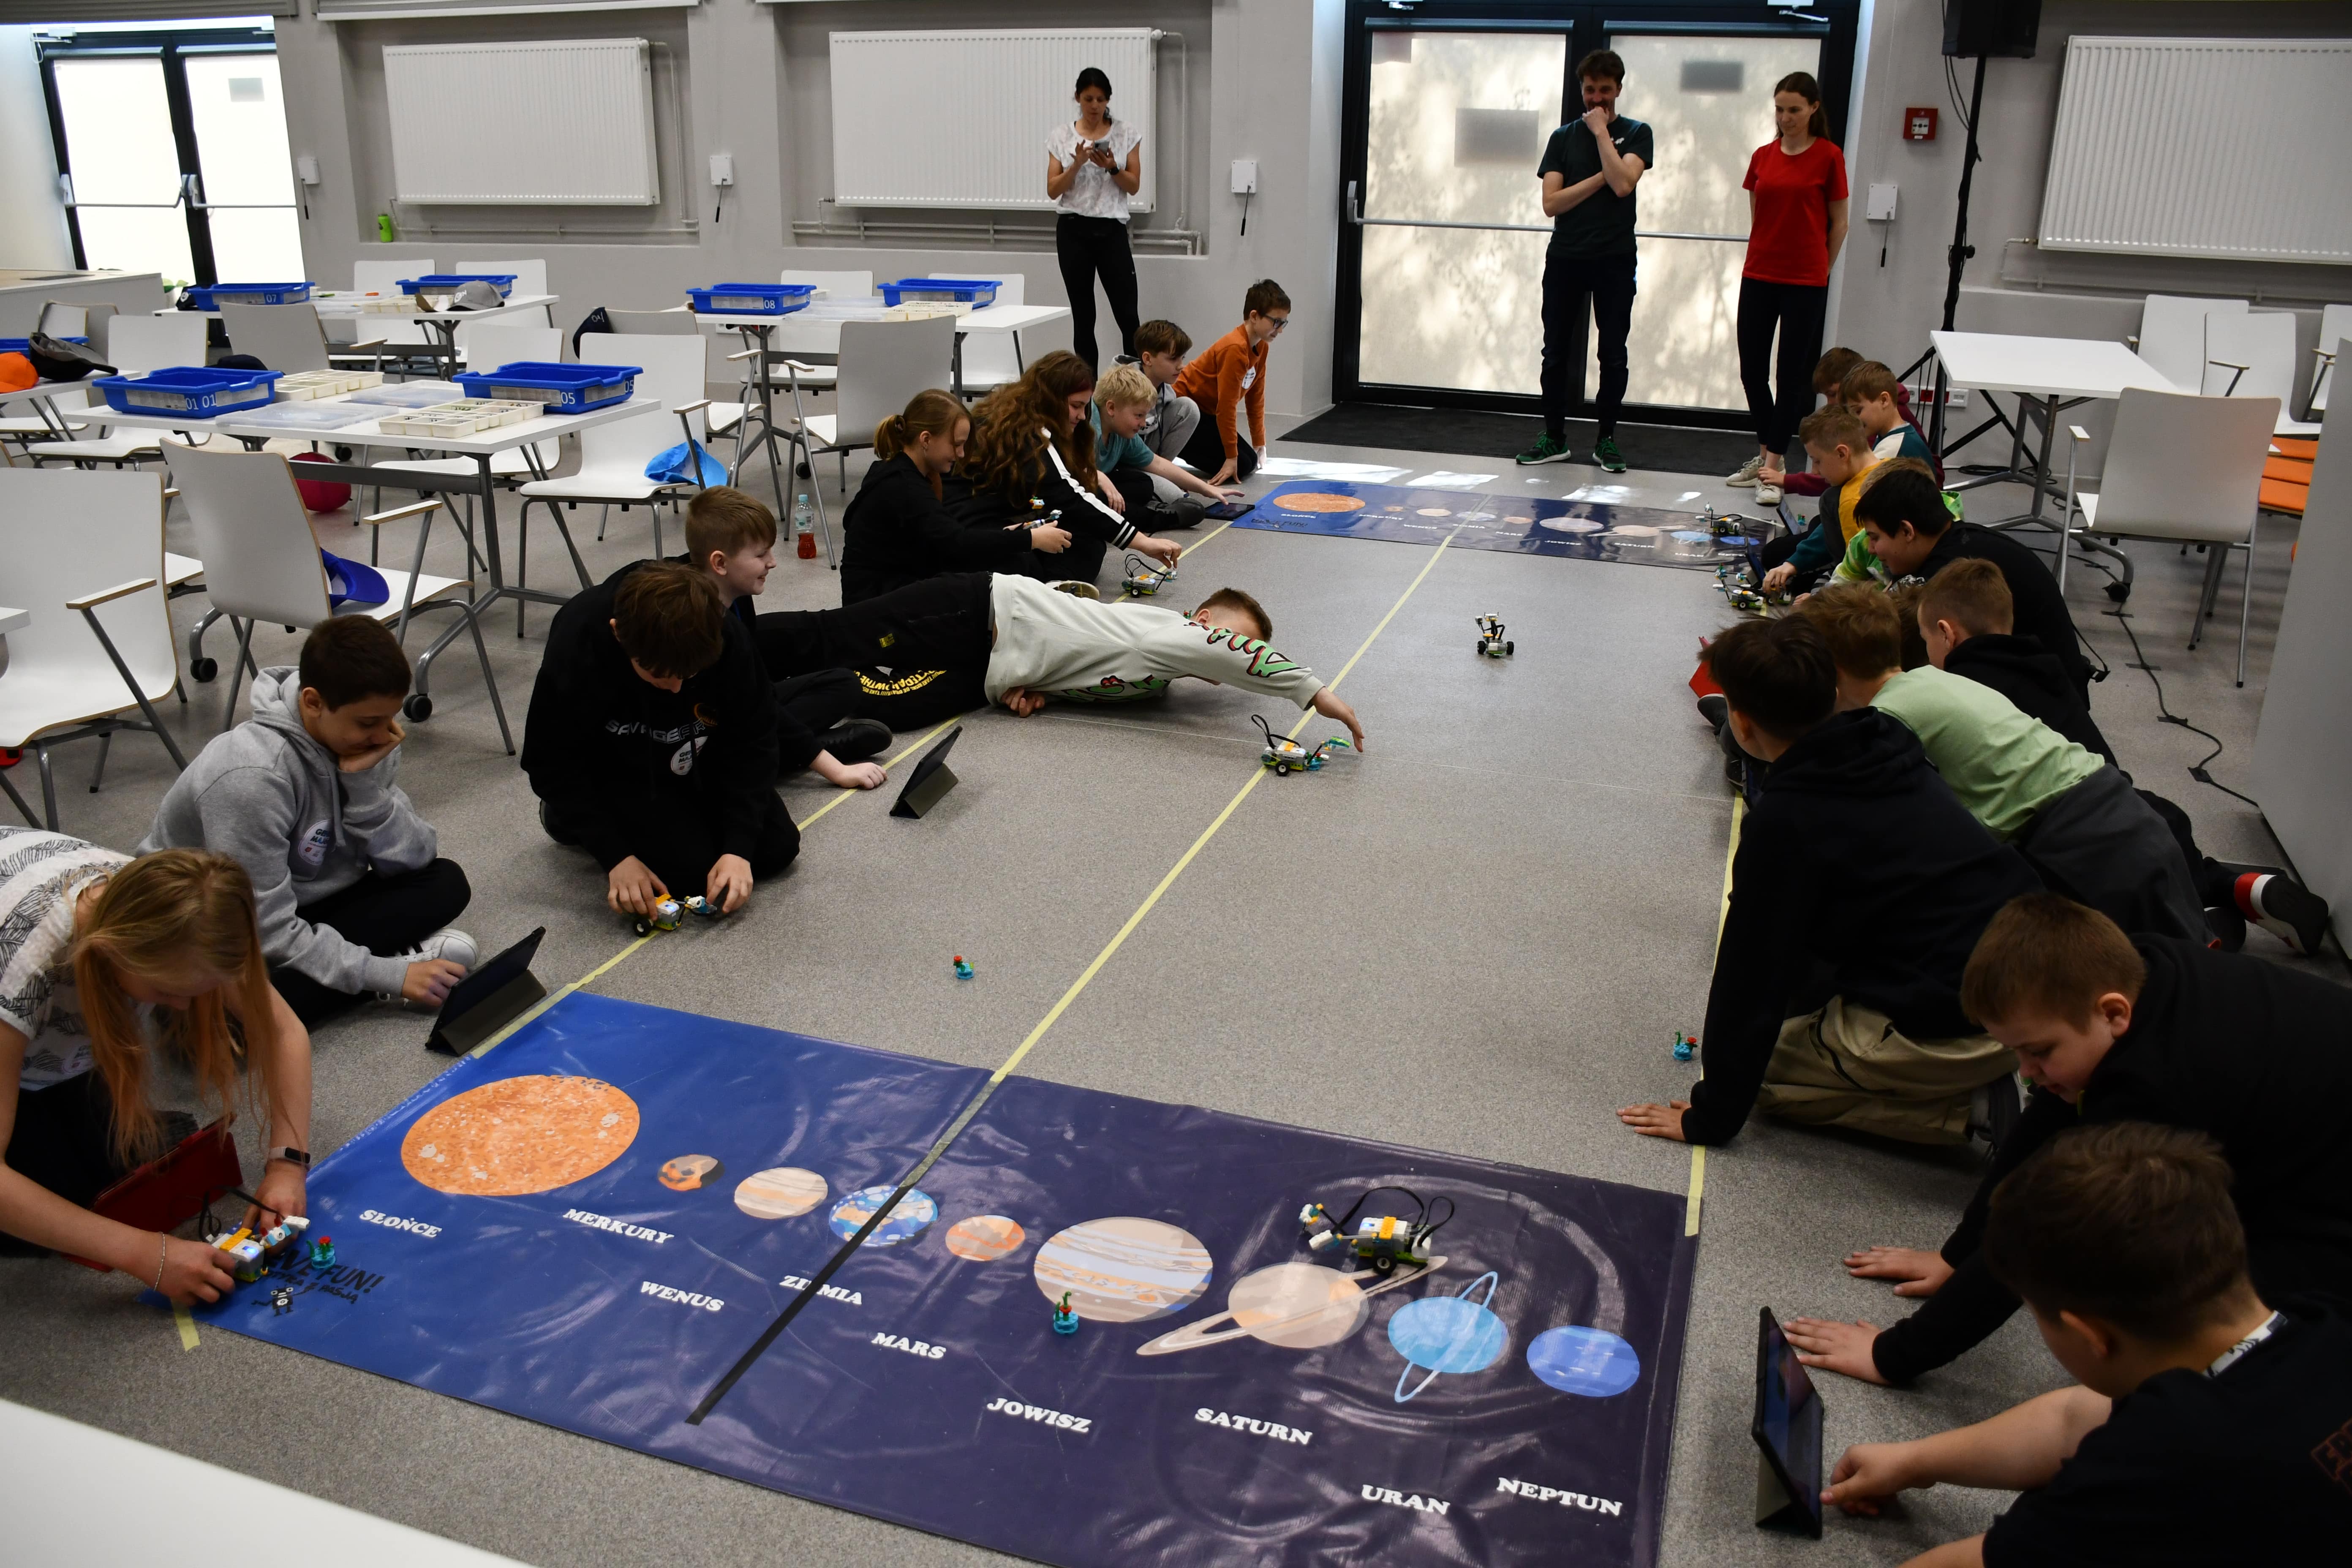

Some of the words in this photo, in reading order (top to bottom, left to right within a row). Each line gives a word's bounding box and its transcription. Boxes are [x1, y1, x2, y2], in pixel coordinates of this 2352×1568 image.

[266, 294, 277, 303] 07
[764, 300, 776, 309] 08
[202, 394, 217, 408] 01
[561, 392, 576, 405] 05
[621, 380, 634, 394] 05
[185, 397, 199, 411] 01
[359, 1209, 442, 1238] SŁOŃCE
[563, 1209, 674, 1243] MERKURY
[316, 1263, 385, 1293] FUN!
[640, 1281, 724, 1311] WENUS
[871, 1332, 947, 1359] MARS
[987, 1398, 1092, 1433] JOWISZ
[1195, 1408, 1313, 1445] SATURN
[1361, 1484, 1451, 1515] URAN
[1496, 1477, 1623, 1516] NEPTUN
